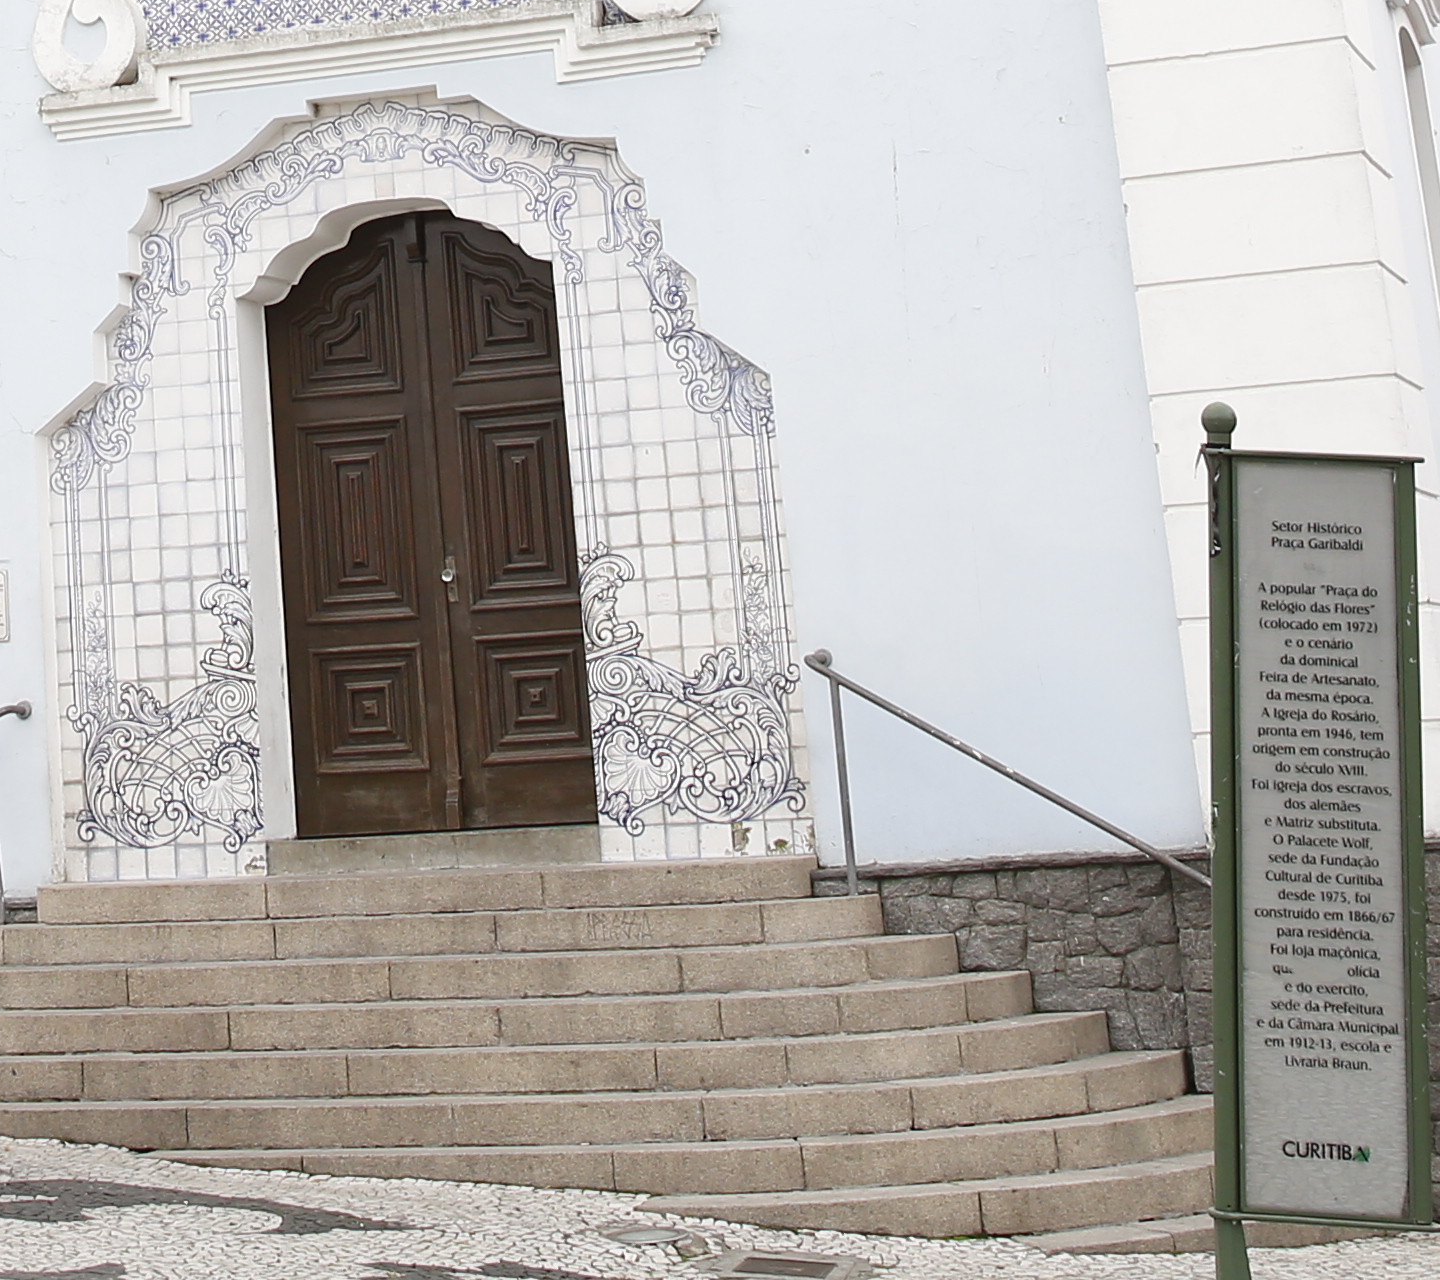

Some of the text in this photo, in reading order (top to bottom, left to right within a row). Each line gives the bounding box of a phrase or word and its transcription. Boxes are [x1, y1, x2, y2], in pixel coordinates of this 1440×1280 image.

[1272, 520, 1362, 535] Setor Histórico
[1271, 537, 1363, 551] Praça Garibaldi
[1258, 583, 1266, 593] A
[1271, 583, 1316, 595] popular
[1362, 587, 1378, 597] do
[1261, 600, 1306, 614] Relógio
[1310, 602, 1331, 613] das
[1259, 618, 1378, 633] (colocado em 1972)
[1285, 638, 1353, 650] e o cenário
[1280, 654, 1358, 668] da dominical
[1260, 671, 1379, 688] Feira de Artesanato,
[1266, 690, 1373, 705] da mesma época.
[1261, 707, 1379, 724] A Igreja do Rosário,
[1258, 726, 1384, 741] pronta em 1946, tem
[1253, 743, 1390, 761] origem em construção
[1275, 761, 1367, 776] do século XVIII.
[1252, 779, 1392, 797] Foi igreja dos escravos,
[1284, 798, 1361, 812] dos alemães
[1265, 816, 1381, 832] e Matriz substituta.
[1273, 834, 1373, 850] O Palacete Wolf,
[1269, 852, 1379, 869] sede da Fundação
[1265, 870, 1383, 886] Cultural de Curitiba
[1278, 889, 1371, 904] desde 1975, foi
[1254, 907, 1395, 924] construído em 1866/67
[1277, 927, 1374, 941] para residência.
[1271, 943, 1381, 961] Foi loja maçônica,
[1348, 966, 1380, 978] olícia
[1285, 984, 1292, 993] e
[1297, 982, 1313, 993] do
[1271, 1000, 1384, 1016] sede da Prefeitura
[1257, 1018, 1399, 1036] e da Câmara Municipal
[1265, 1037, 1392, 1053] em 1912-13, escola e
[1285, 1056, 1372, 1071] Livraria Braun.
[1282, 1141, 1370, 1162] CURITIBA
